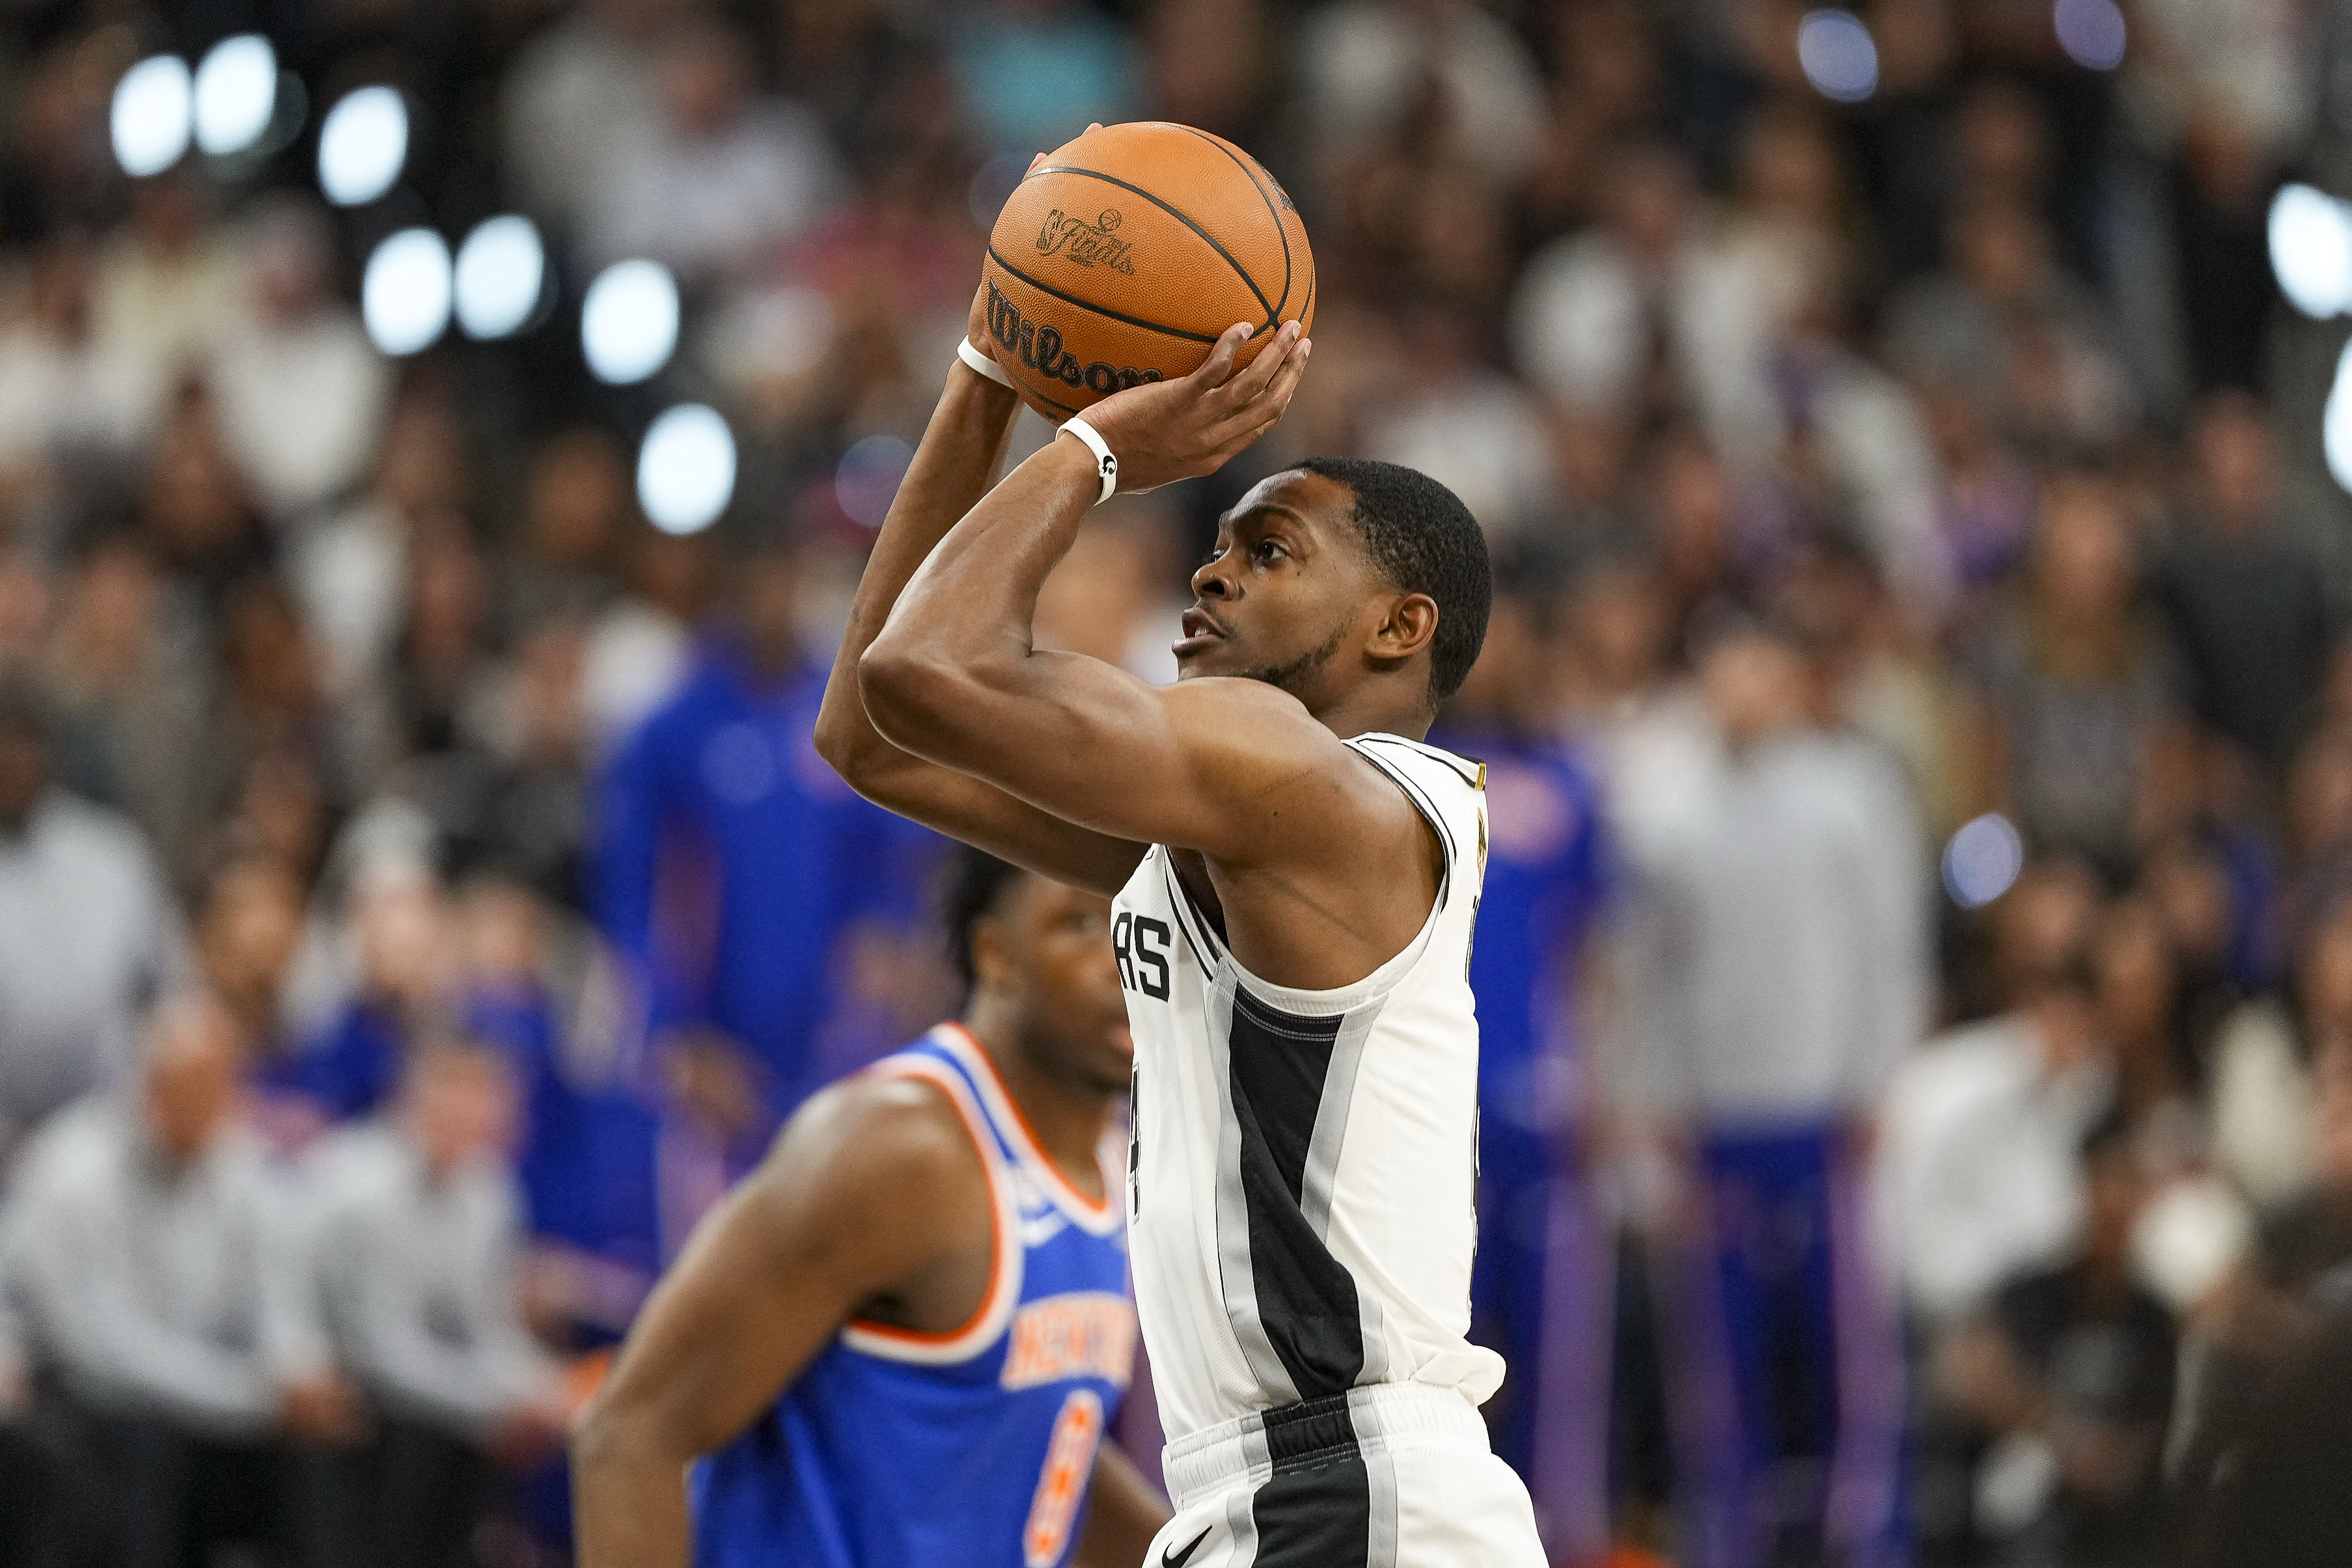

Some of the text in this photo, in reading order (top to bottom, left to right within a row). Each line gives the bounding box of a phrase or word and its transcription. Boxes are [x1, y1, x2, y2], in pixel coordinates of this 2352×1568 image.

[1040, 218, 1135, 276] Finals
[988, 279, 1163, 396] Wilson
[1113, 912, 1170, 1002] RS
[1023, 1388, 1104, 1568] 8
